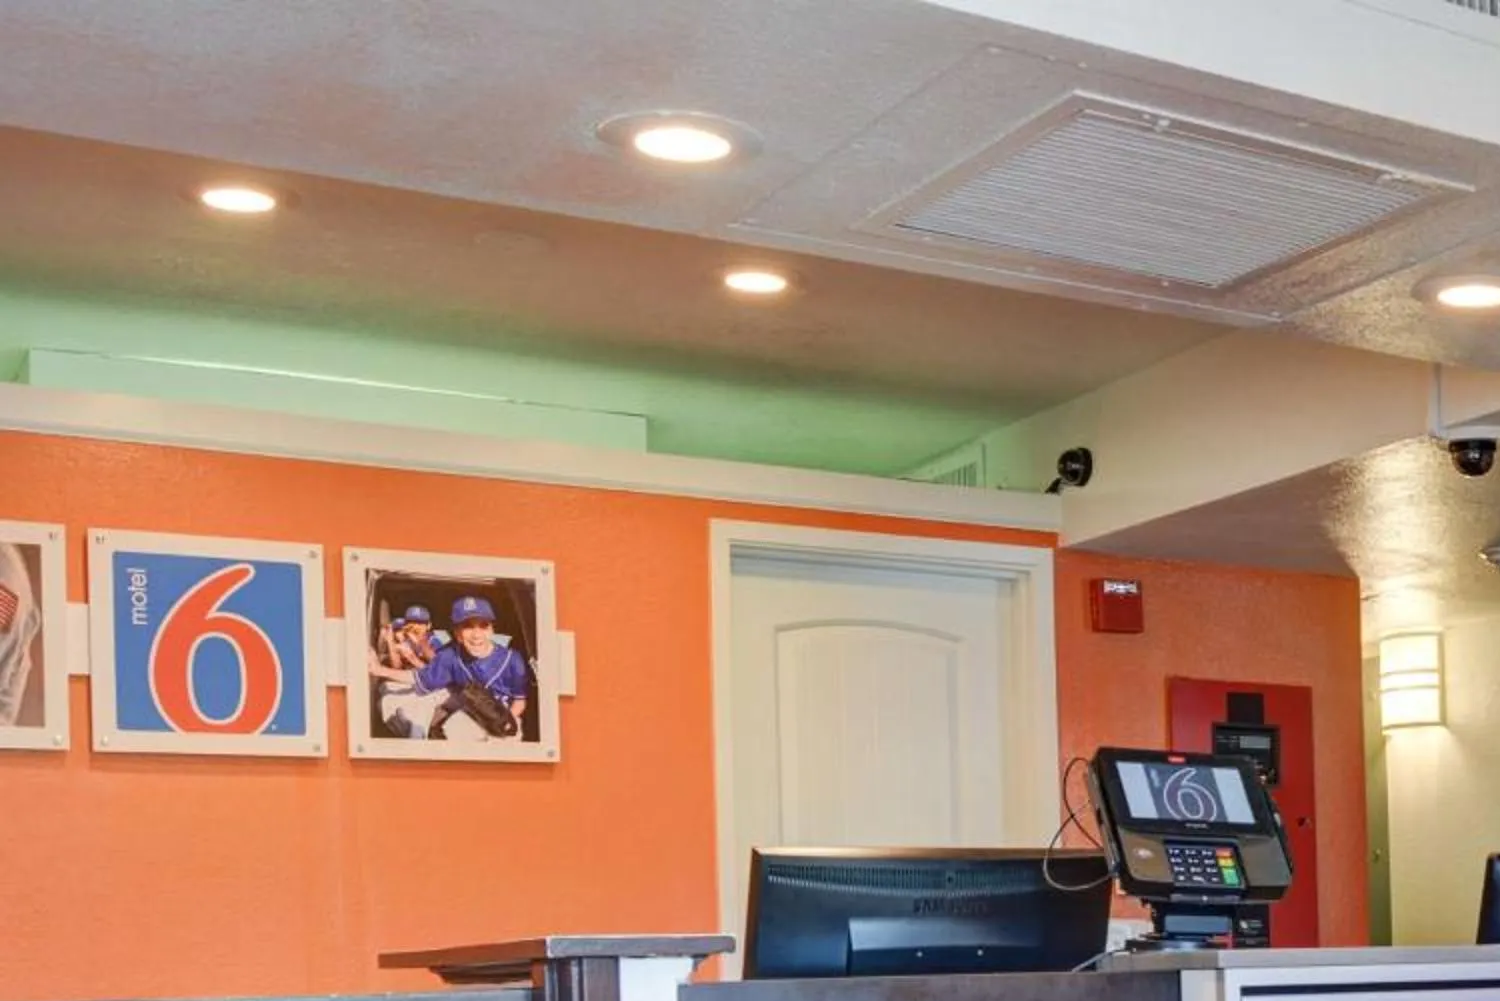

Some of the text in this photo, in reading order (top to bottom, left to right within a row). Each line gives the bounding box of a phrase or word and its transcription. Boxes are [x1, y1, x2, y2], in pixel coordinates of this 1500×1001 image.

[126, 567, 148, 626] motel
[147, 562, 283, 735] 6
[1164, 767, 1217, 822] 6
